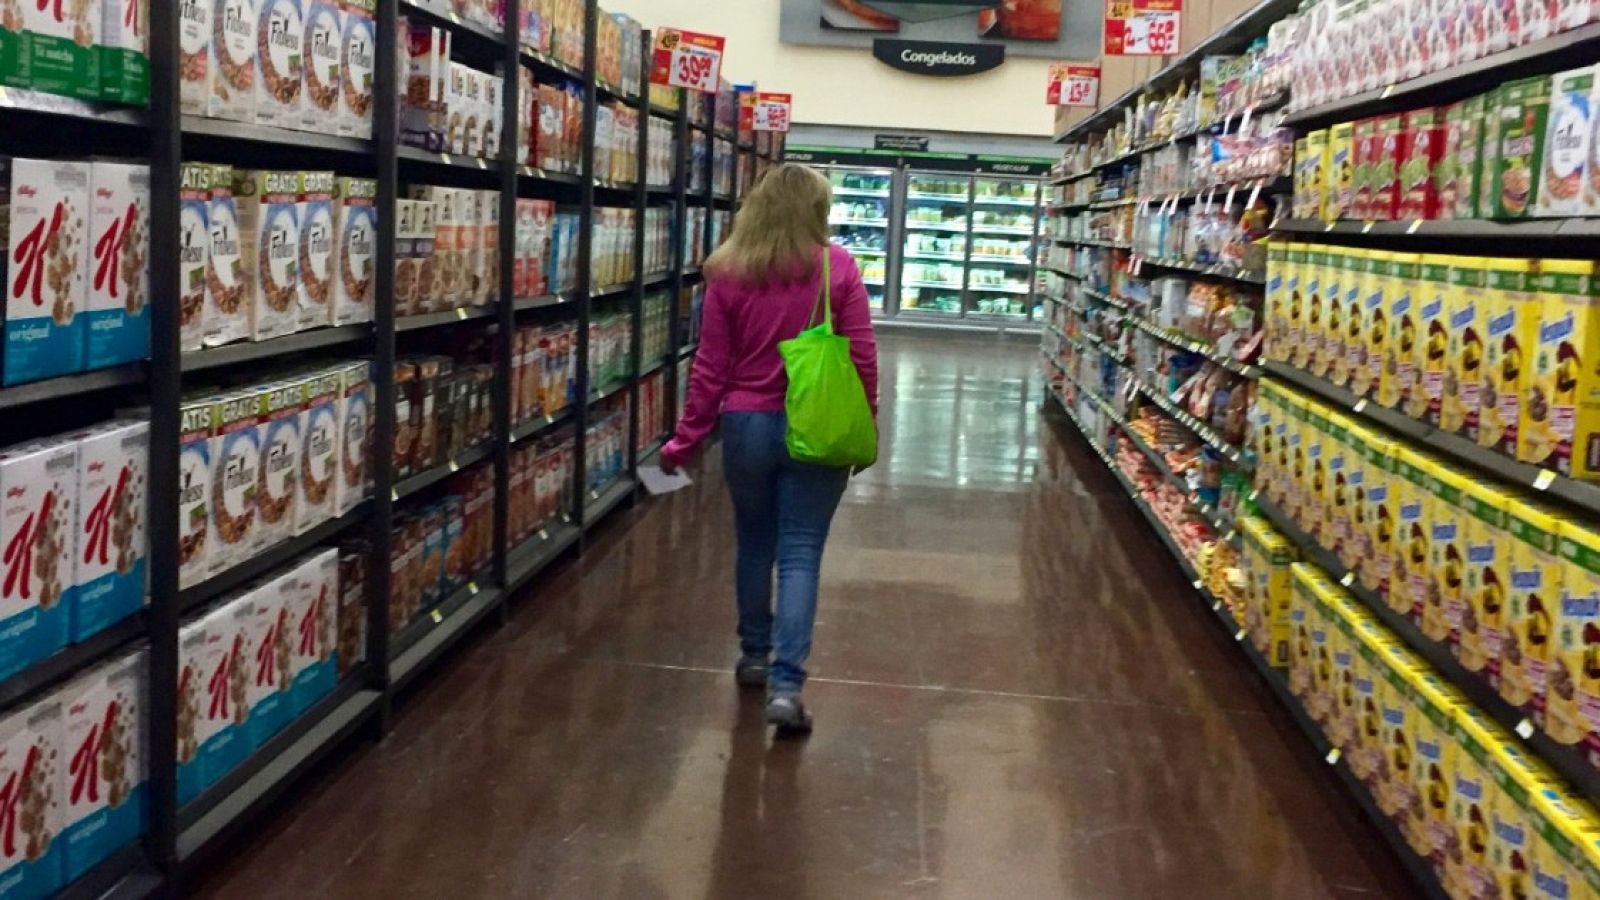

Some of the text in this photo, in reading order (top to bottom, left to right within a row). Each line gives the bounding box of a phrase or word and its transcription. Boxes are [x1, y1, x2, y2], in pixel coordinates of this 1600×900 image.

[271, 19, 299, 50] Fitness
[901, 49, 976, 67] Congelados
[182, 166, 209, 189] ATIS
[265, 173, 298, 193] GRATIS
[303, 173, 334, 192] GRATIS
[267, 388, 301, 411] GRATIS
[181, 405, 211, 432] ATIS
[223, 400, 261, 423] GRATIS
